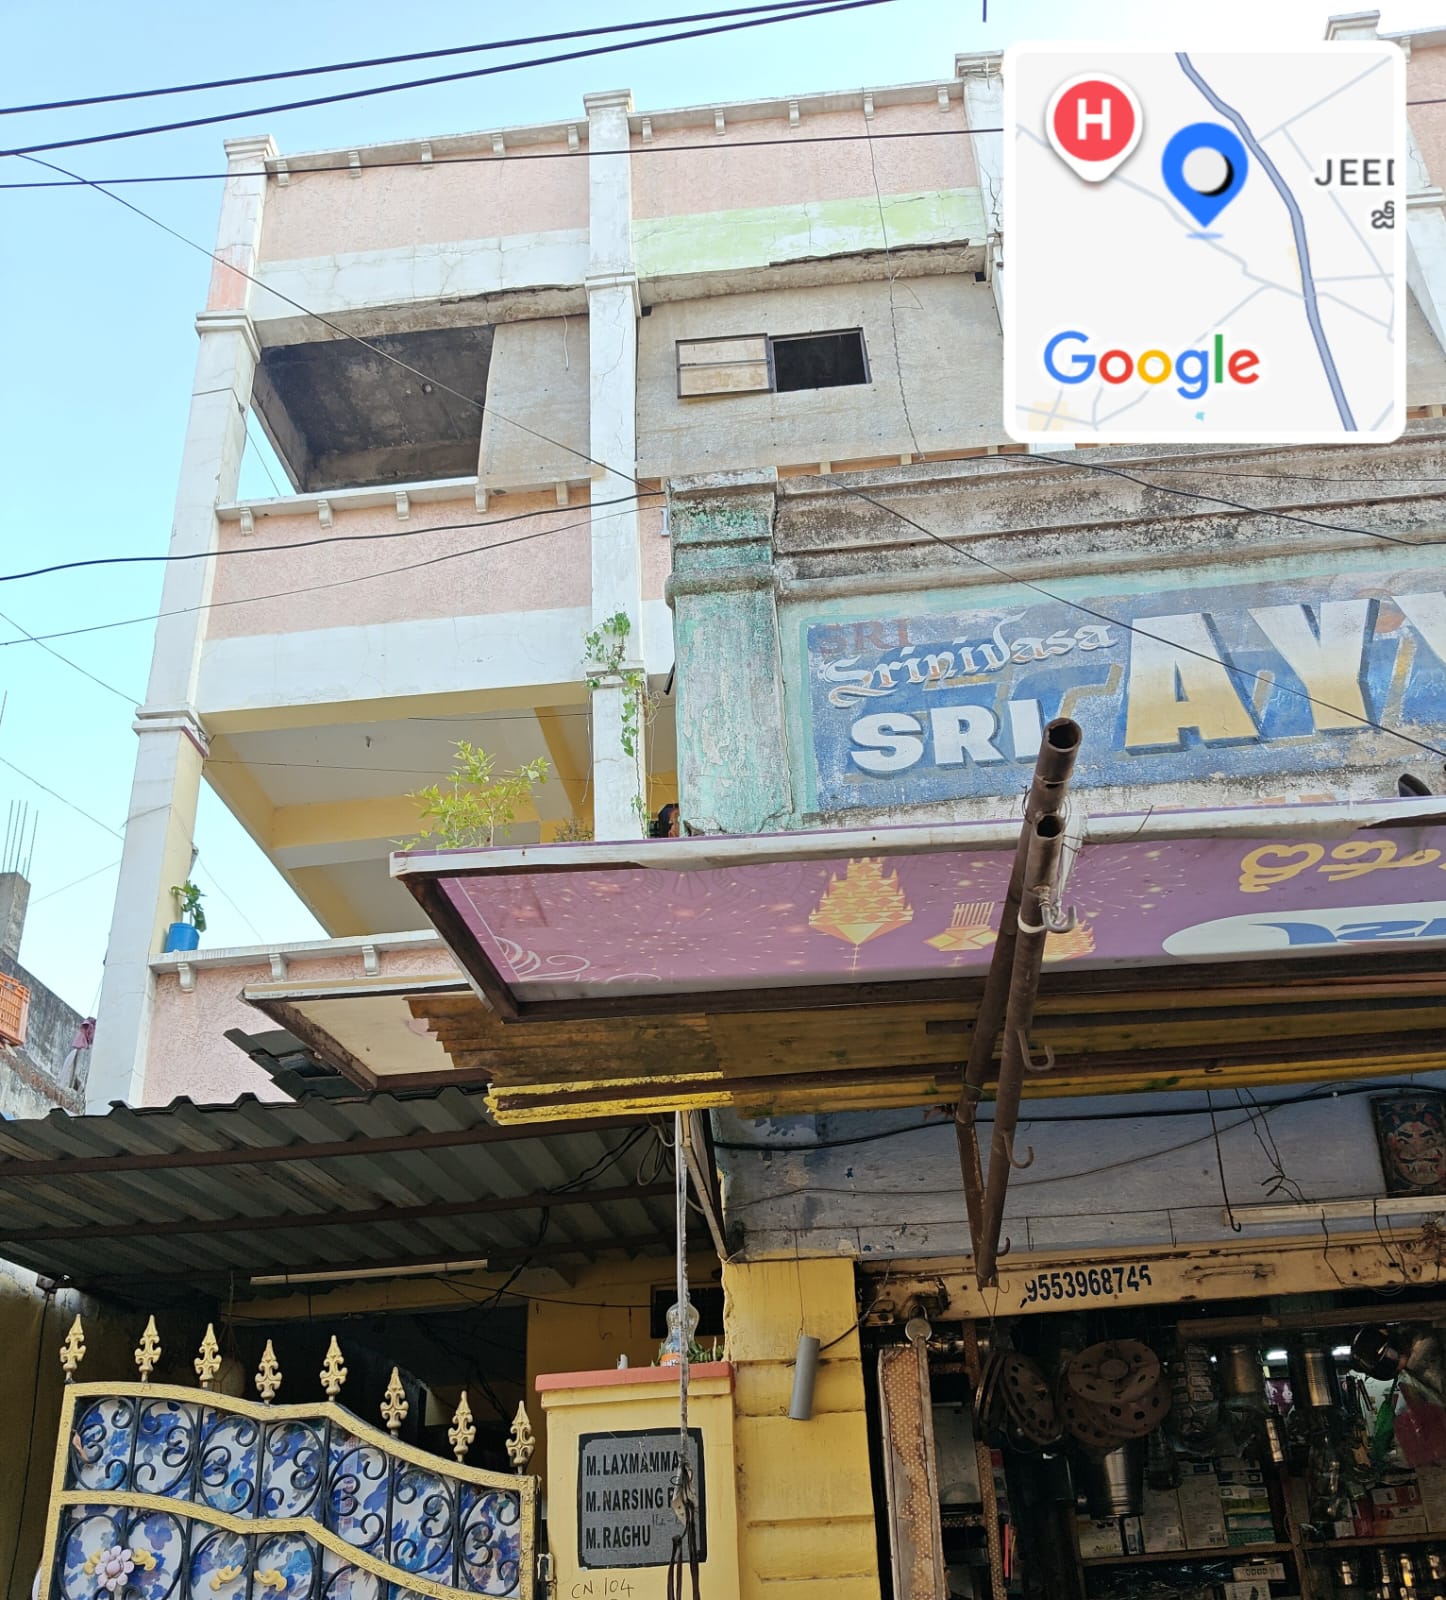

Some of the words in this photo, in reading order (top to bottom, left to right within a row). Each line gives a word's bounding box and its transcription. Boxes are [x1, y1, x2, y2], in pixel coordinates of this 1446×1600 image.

[820, 611, 1120, 708] Srinivasa
[849, 698, 1044, 772] SRI
[604, 1577, 634, 1597] 104
